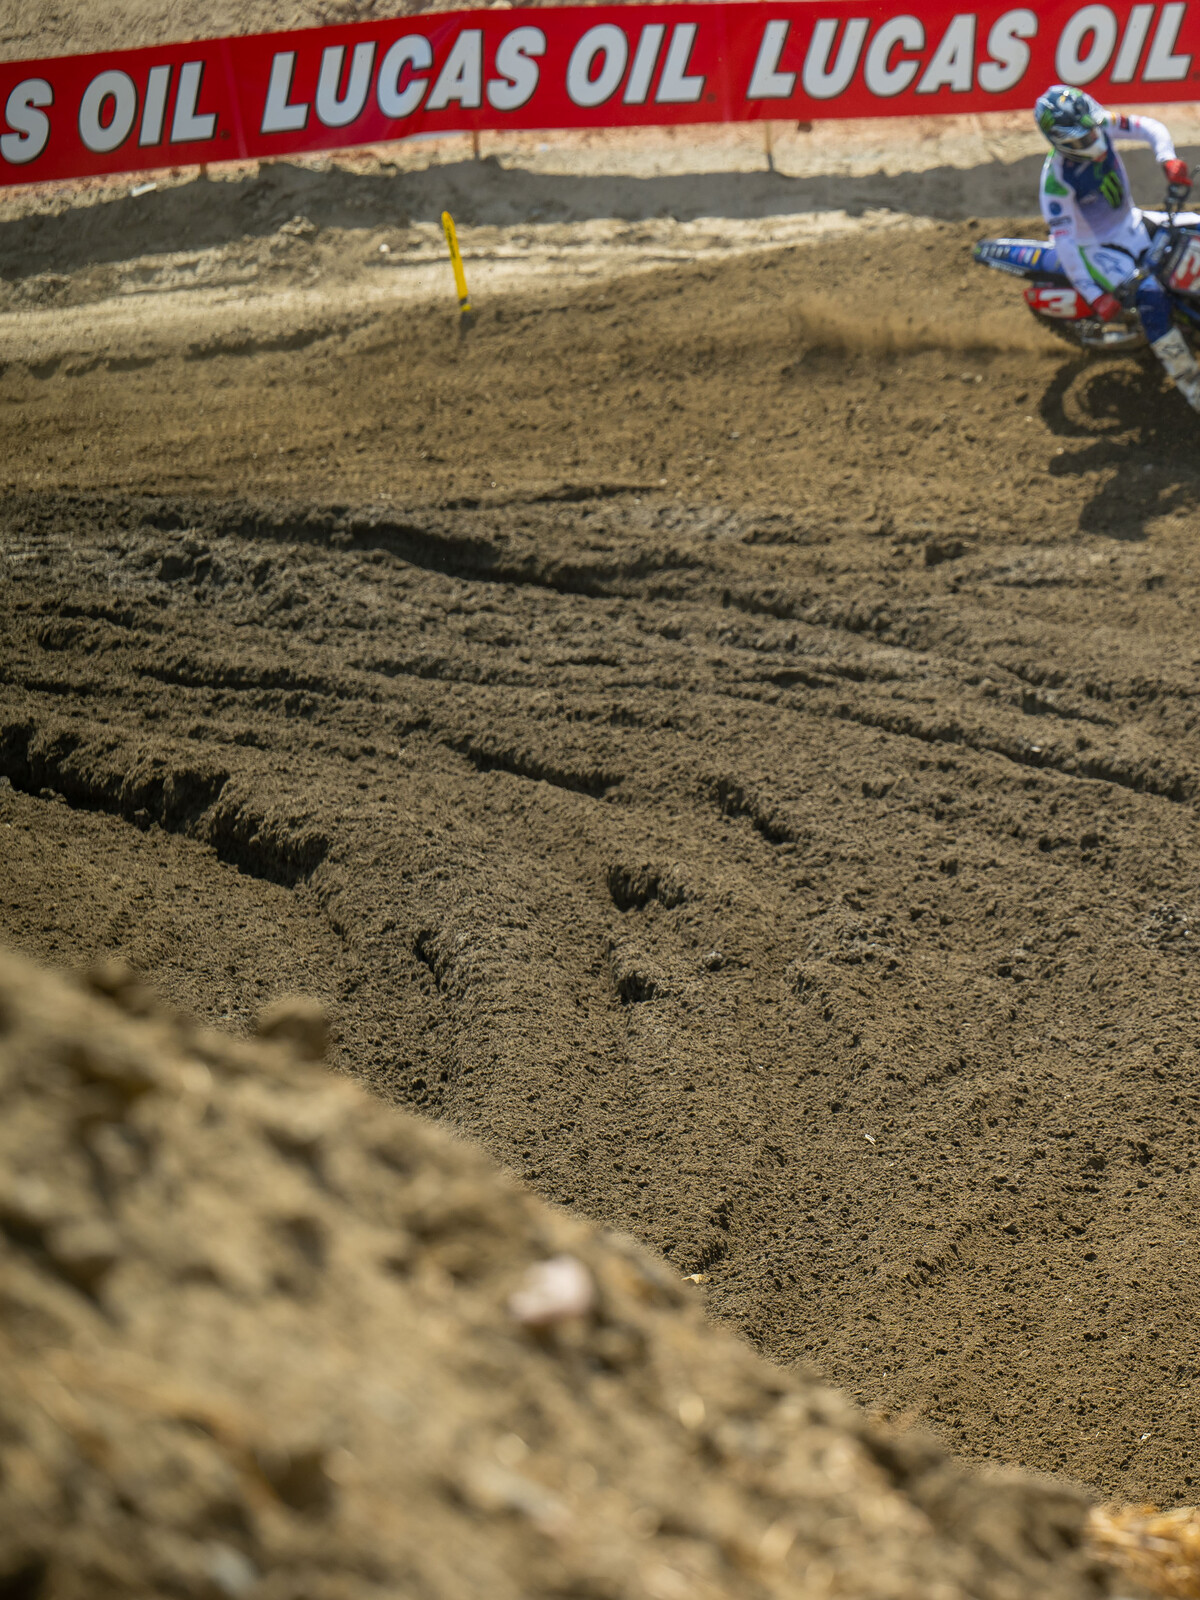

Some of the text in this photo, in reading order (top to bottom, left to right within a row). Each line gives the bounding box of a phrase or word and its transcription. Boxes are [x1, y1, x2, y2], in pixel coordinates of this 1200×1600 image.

[78, 61, 216, 153] OIL
[260, 26, 546, 134] LUCAS
[565, 23, 705, 105] OIL
[746, 9, 1038, 100] LUCAS
[1054, 3, 1192, 86] OIL
[1038, 288, 1077, 318] 3
